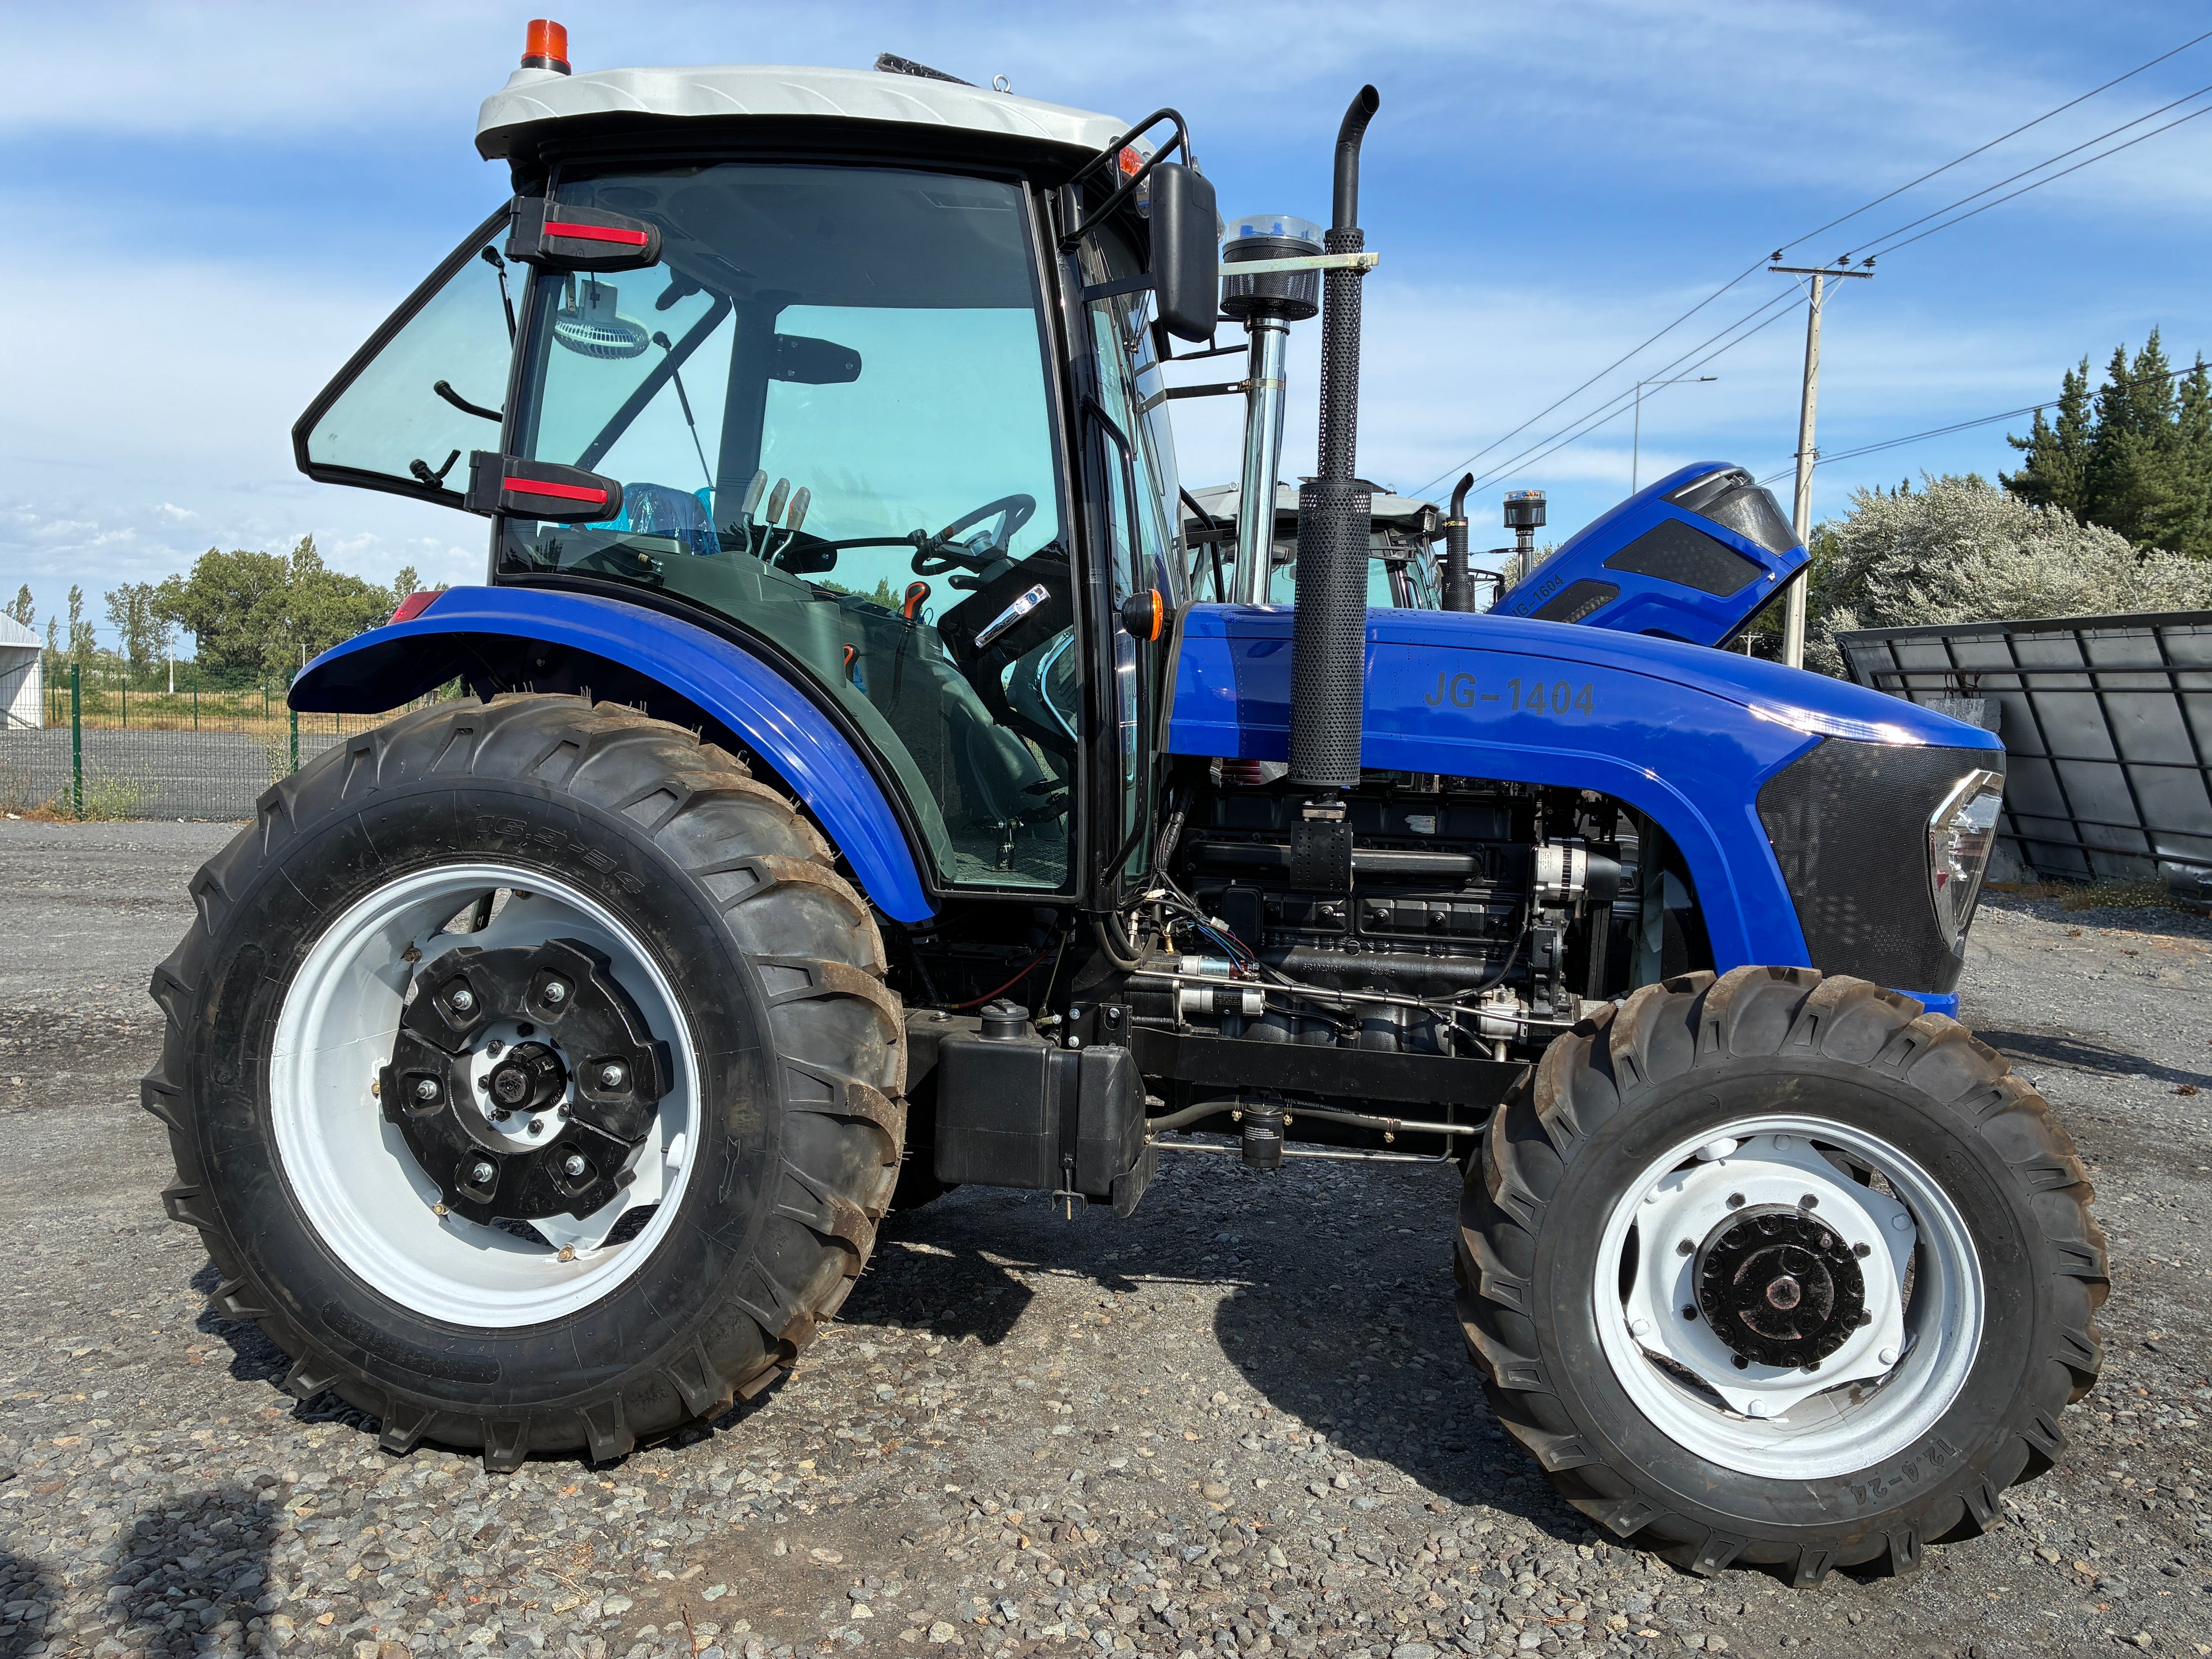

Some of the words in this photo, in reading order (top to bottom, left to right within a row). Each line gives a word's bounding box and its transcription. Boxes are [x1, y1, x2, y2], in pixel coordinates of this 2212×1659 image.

[1425, 672, 1594, 716] JG-1404
[476, 816, 645, 893] 16.9-34
[1851, 1439, 1956, 1505] 12.4-24
